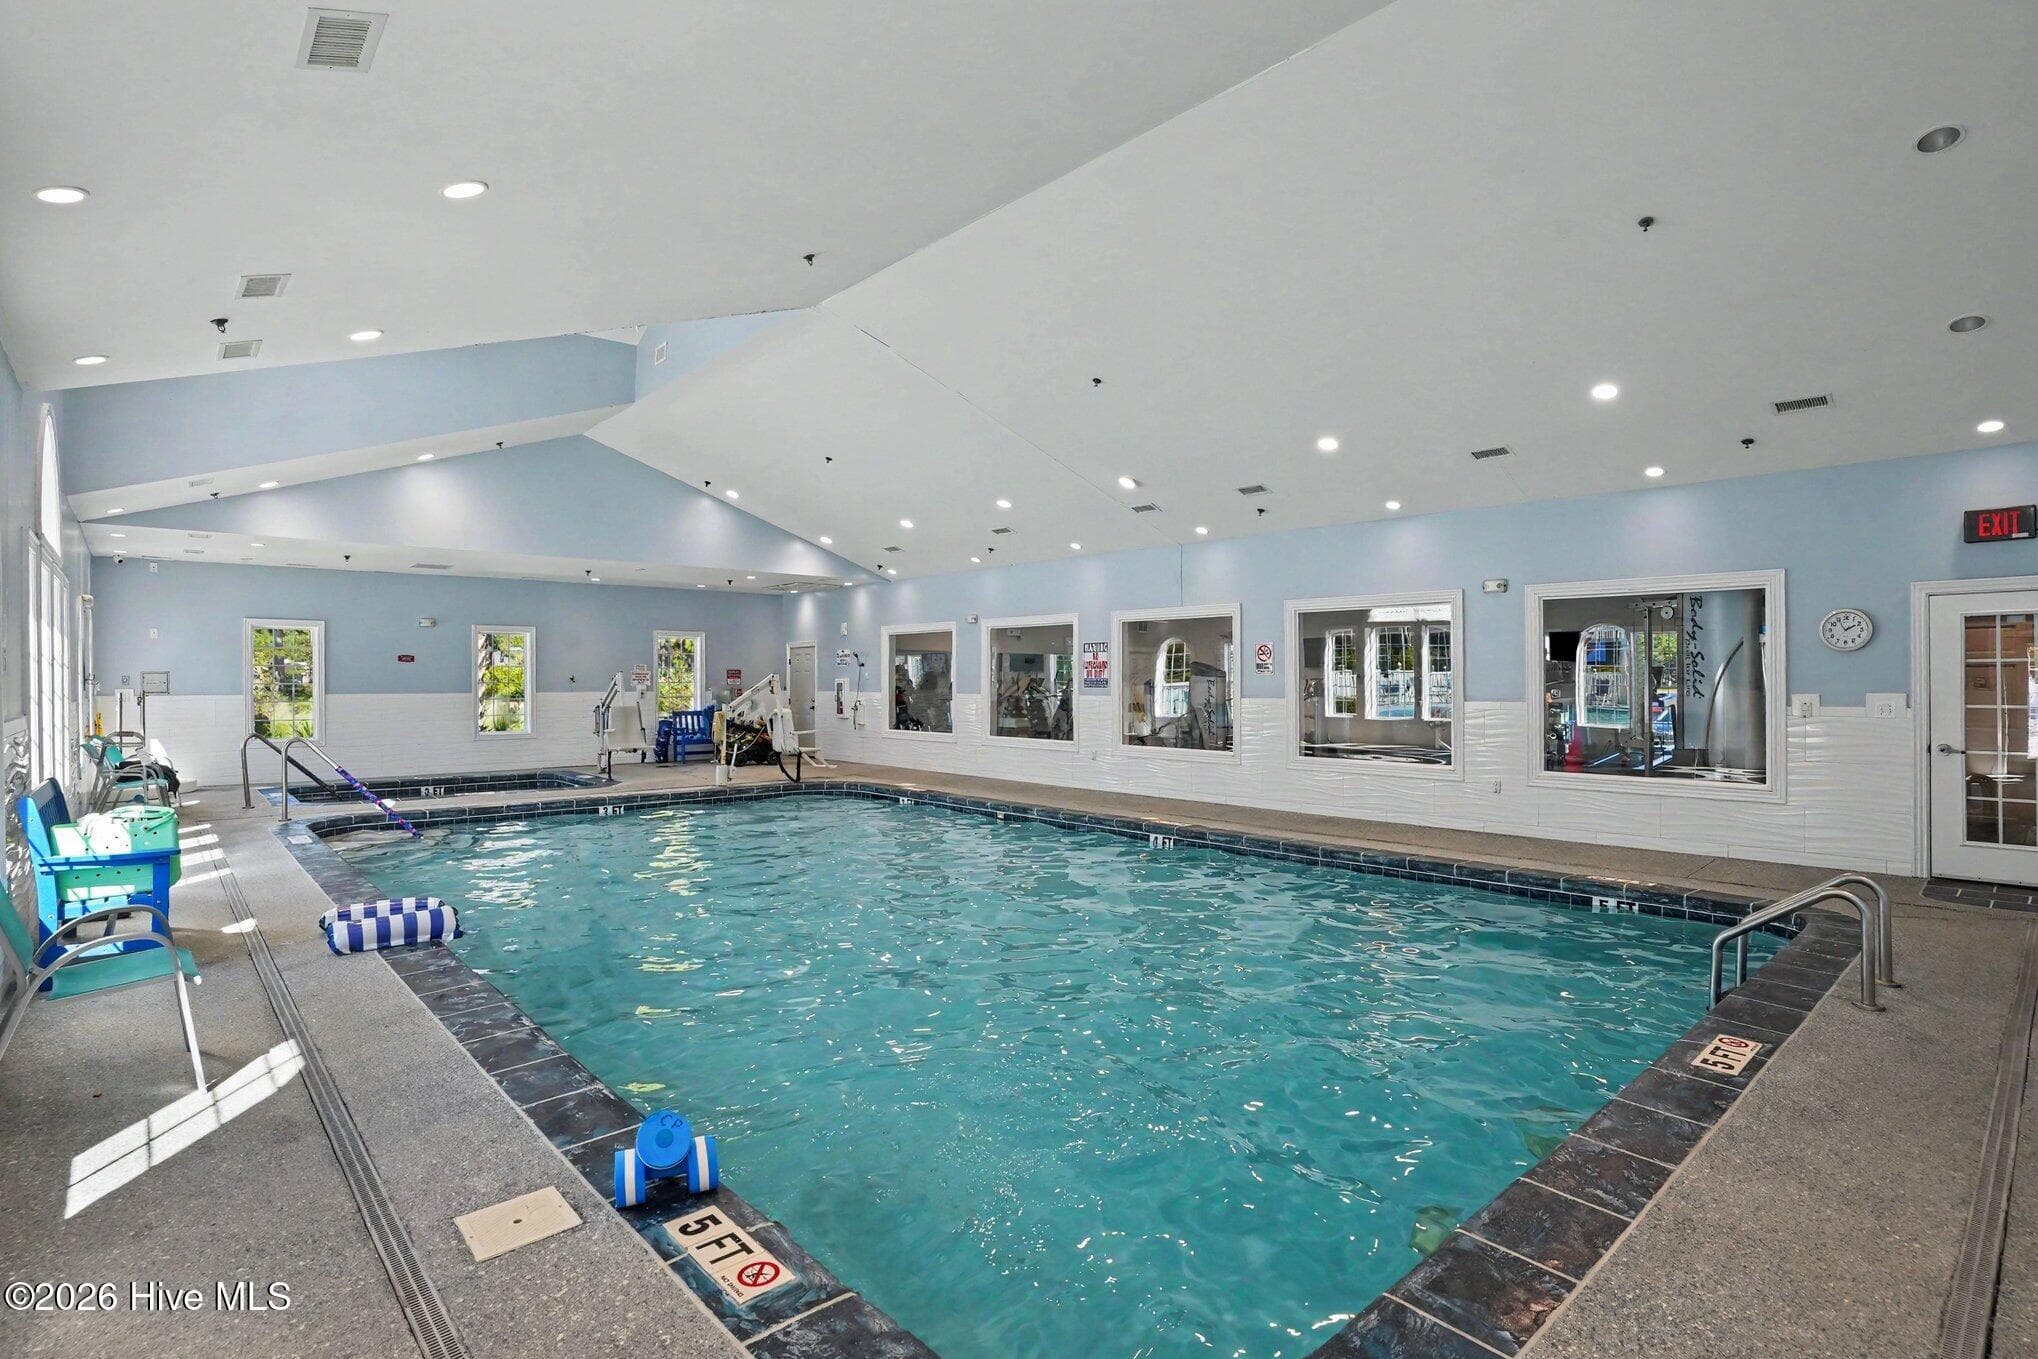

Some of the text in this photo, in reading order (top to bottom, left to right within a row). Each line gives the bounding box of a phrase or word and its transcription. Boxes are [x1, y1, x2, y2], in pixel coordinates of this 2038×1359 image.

[1978, 511, 2019, 537] EXIT
[1687, 595, 1705, 699] Body-Solid
[1700, 1058, 1735, 1070] 5
[1709, 1046, 1747, 1062] FT
[679, 1213, 755, 1265] 5 FT
